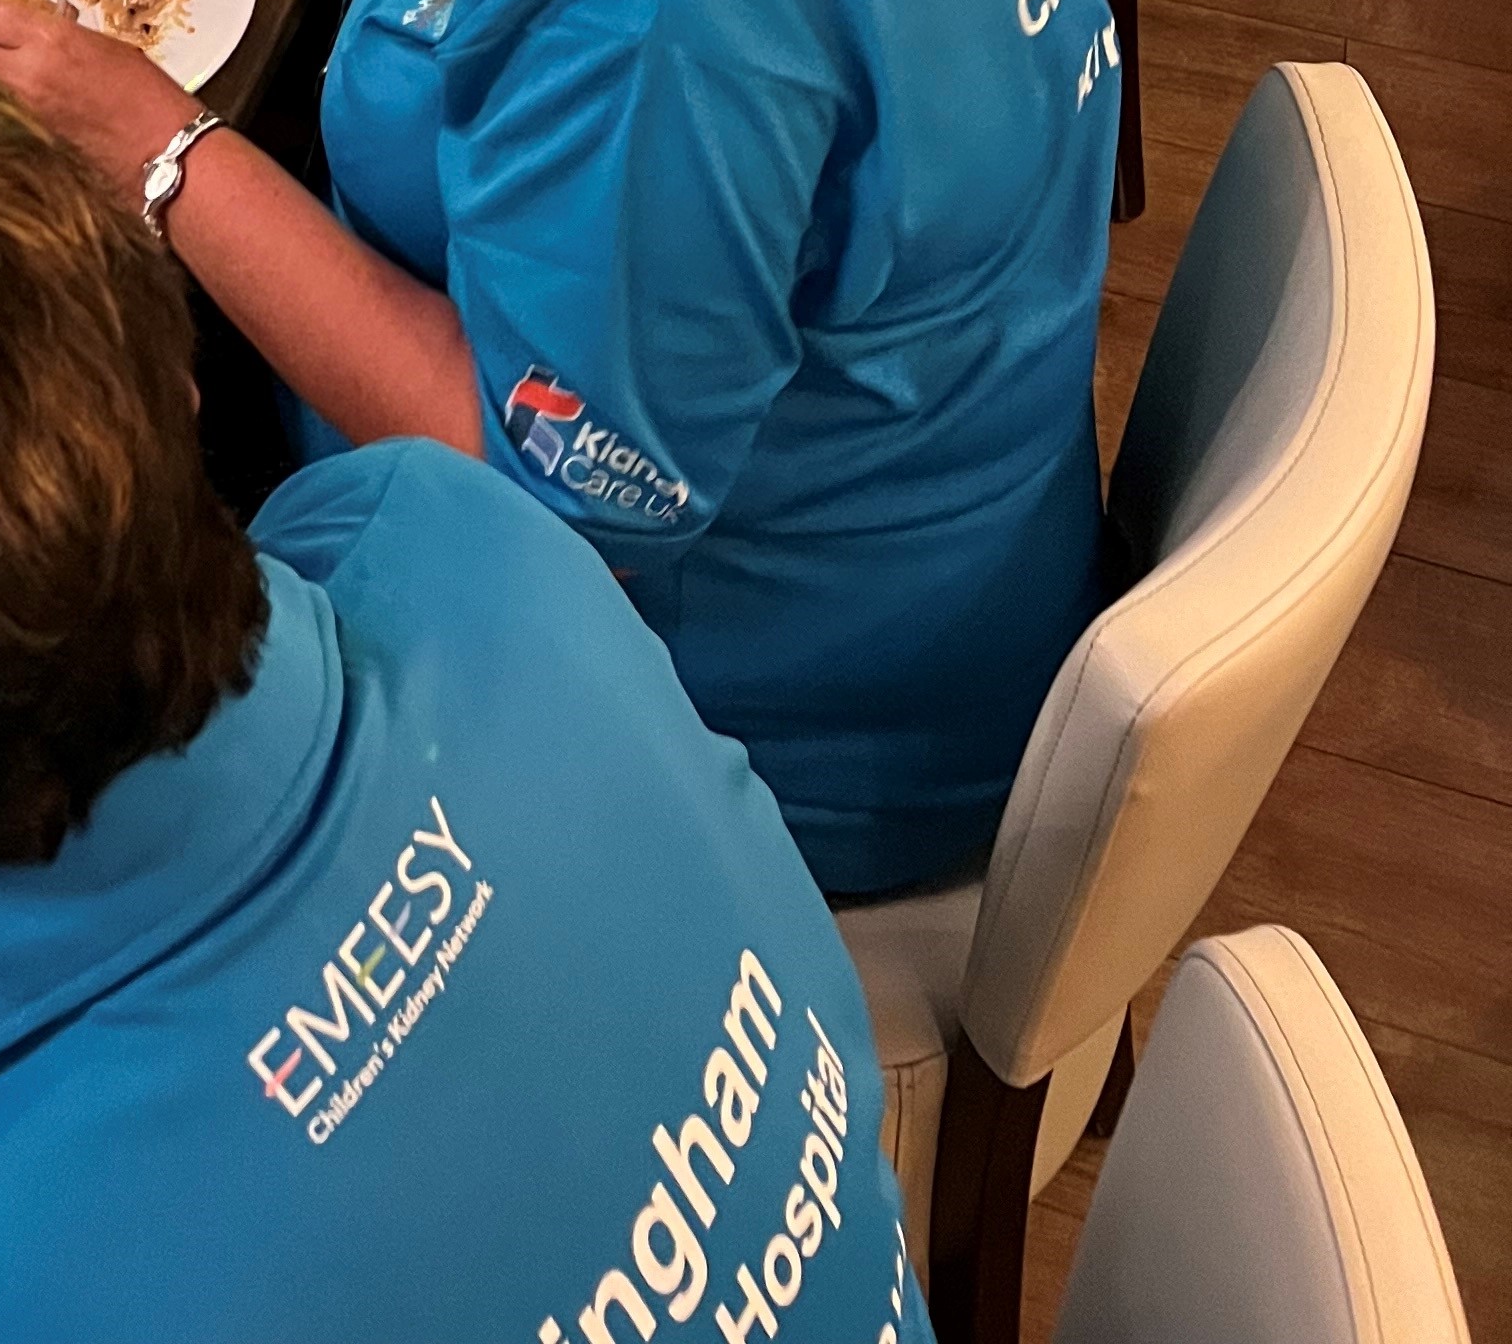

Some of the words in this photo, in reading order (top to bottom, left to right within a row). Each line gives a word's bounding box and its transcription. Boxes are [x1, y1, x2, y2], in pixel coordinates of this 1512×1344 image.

[560, 454, 644, 510] Care
[247, 795, 472, 1118] EMEESY
[306, 1041, 395, 1145] Children's
[387, 965, 445, 1045] Kidney
[436, 879, 494, 973] Network
[714, 1006, 848, 1344] Hospital
